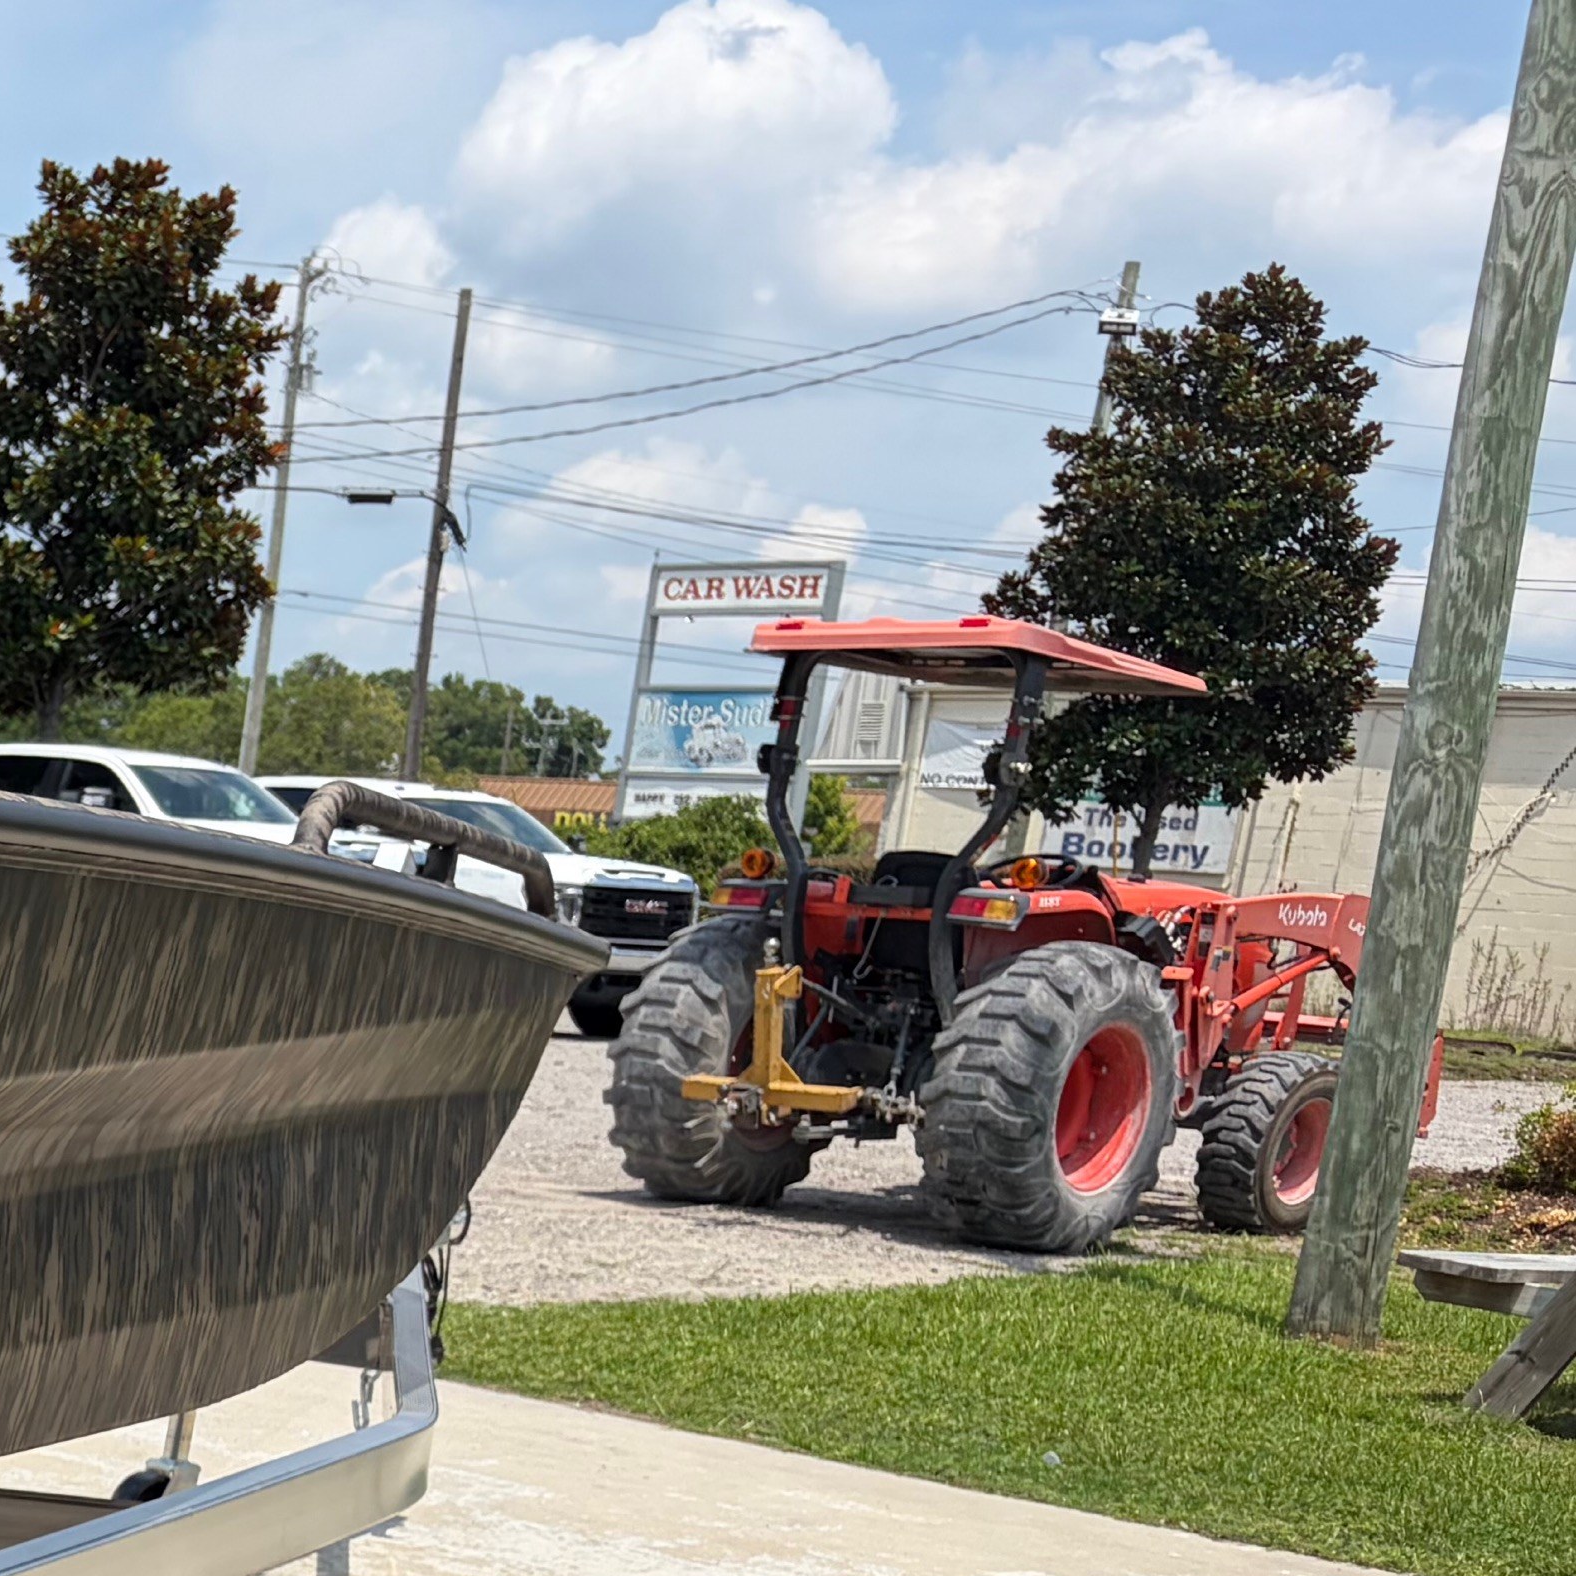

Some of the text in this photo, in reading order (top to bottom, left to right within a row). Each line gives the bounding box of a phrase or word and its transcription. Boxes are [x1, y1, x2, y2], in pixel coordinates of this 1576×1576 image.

[663, 573, 824, 601] CAR WASH
[643, 697, 715, 727] Mister
[1061, 831, 1210, 870] Booery
[1278, 902, 1328, 927] Kubota
